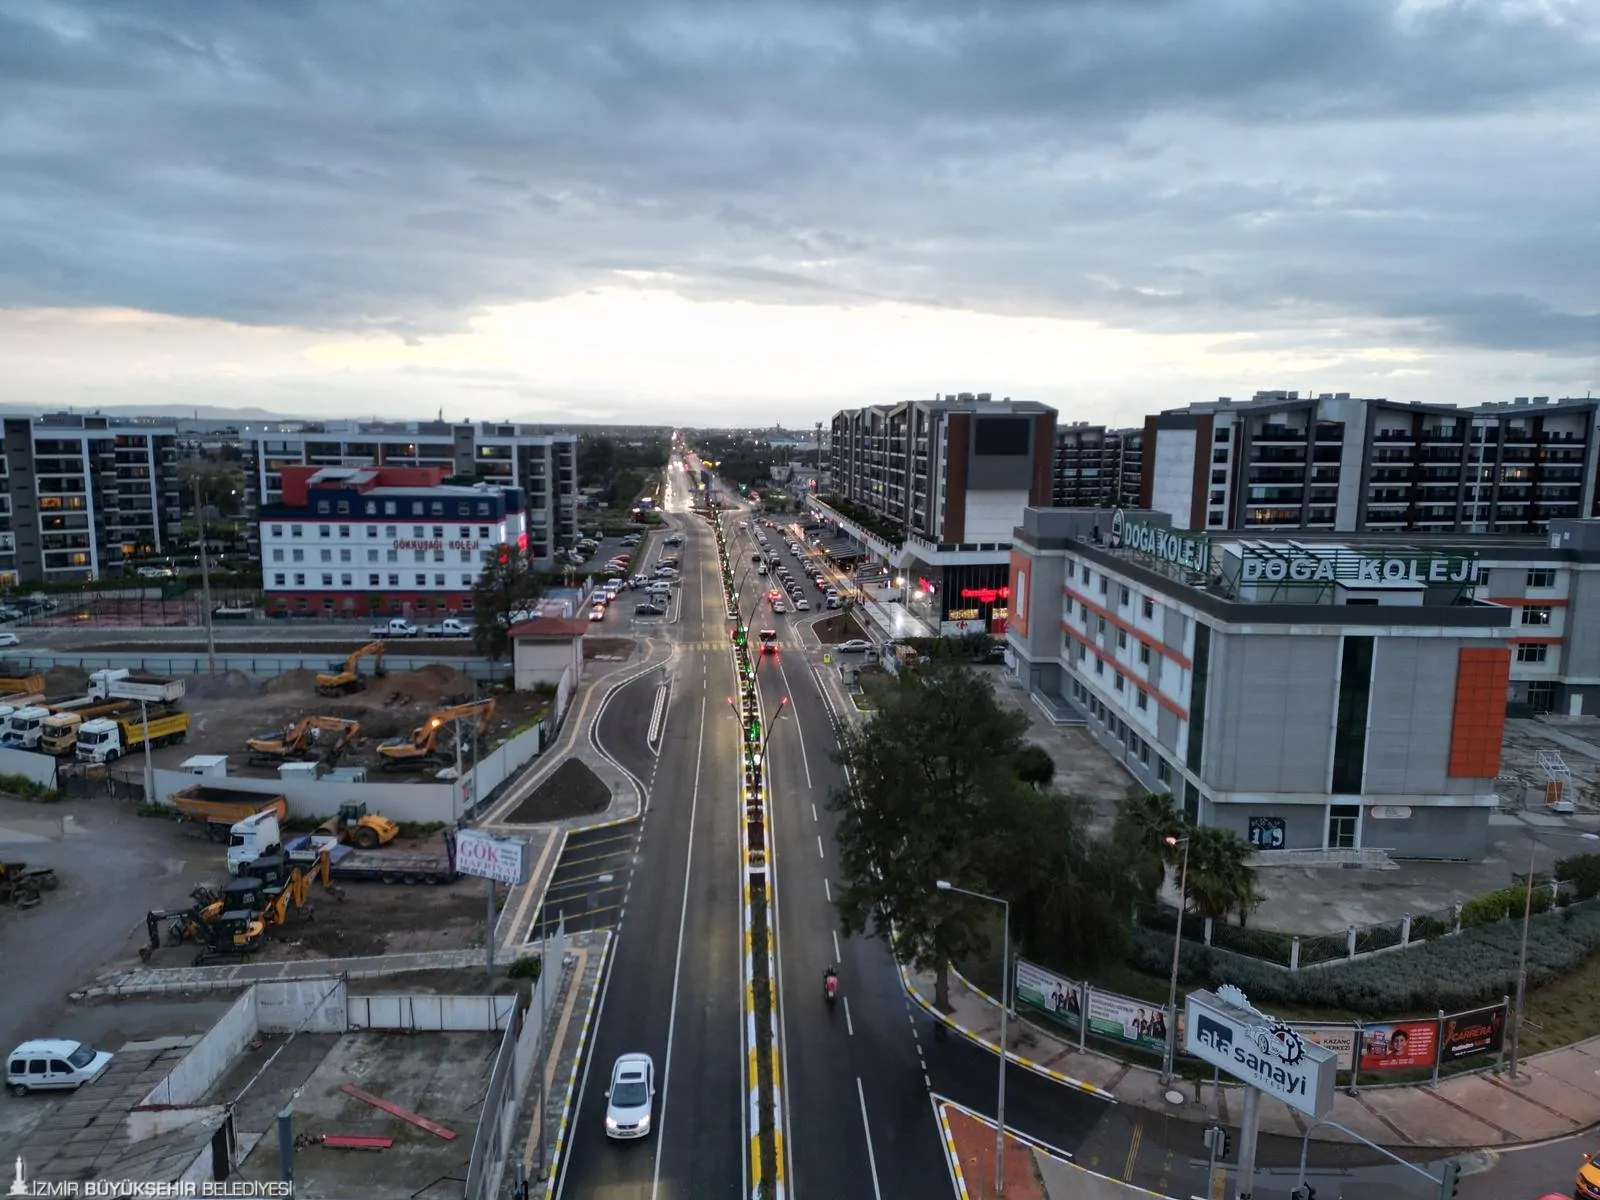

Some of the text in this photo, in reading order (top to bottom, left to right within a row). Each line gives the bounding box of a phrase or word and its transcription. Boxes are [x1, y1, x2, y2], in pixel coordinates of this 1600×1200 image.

[1358, 551, 1479, 582] KOLEJİ
[1200, 1027, 1234, 1056] ata
[1234, 1046, 1307, 1096] sanayi
